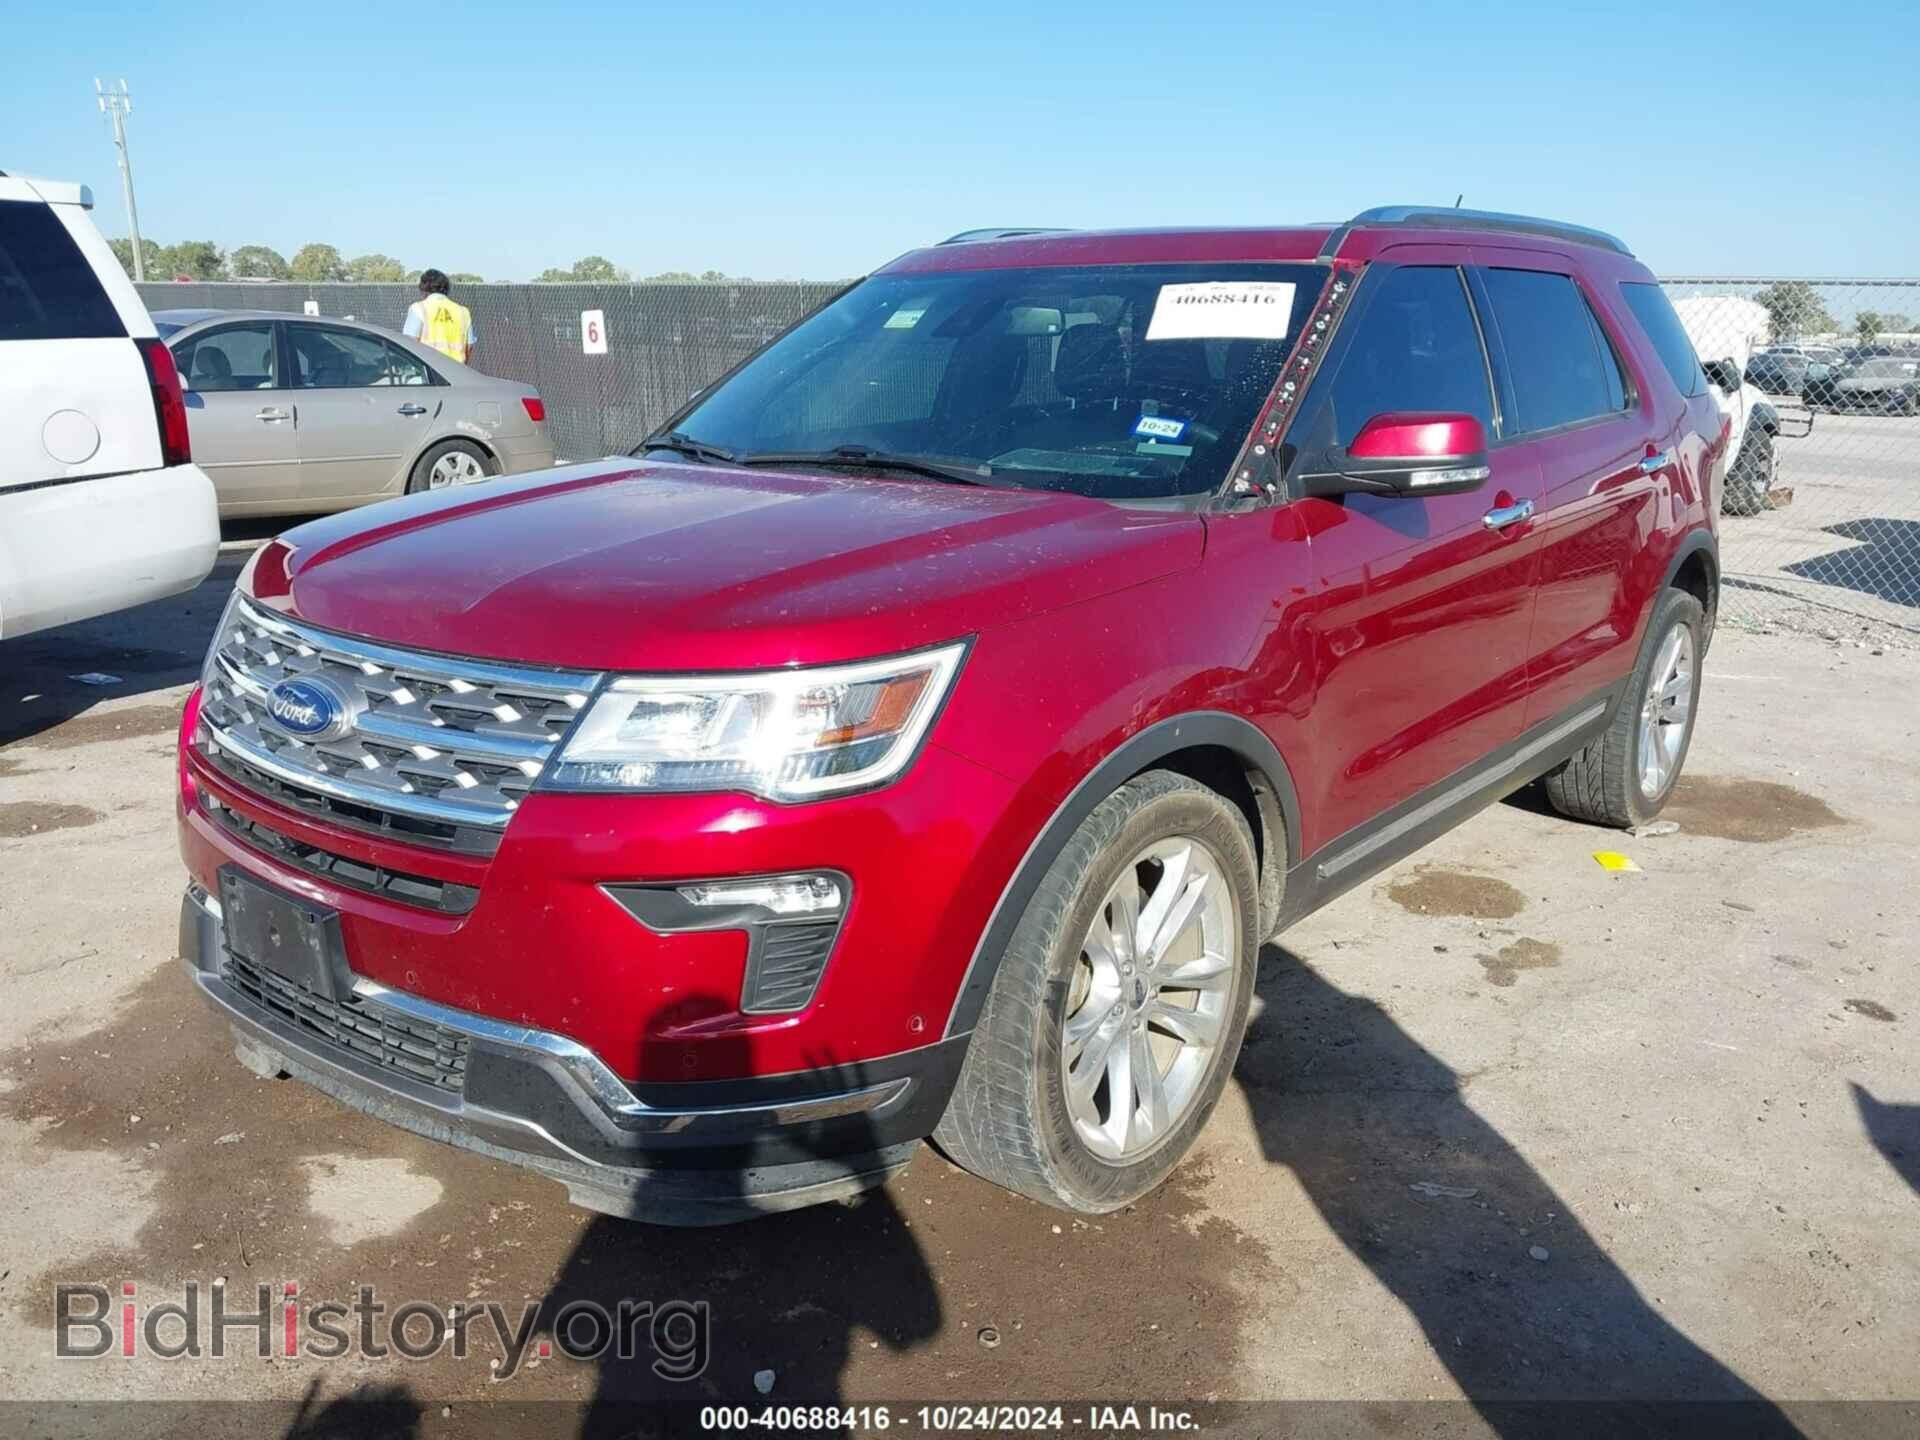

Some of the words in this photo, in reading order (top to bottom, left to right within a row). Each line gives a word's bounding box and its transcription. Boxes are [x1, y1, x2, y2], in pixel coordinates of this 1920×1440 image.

[1172, 294, 1276, 305] 40688416
[588, 321, 599, 344] 6
[1142, 421, 1179, 433] 10-24
[274, 687, 321, 725] Ford
